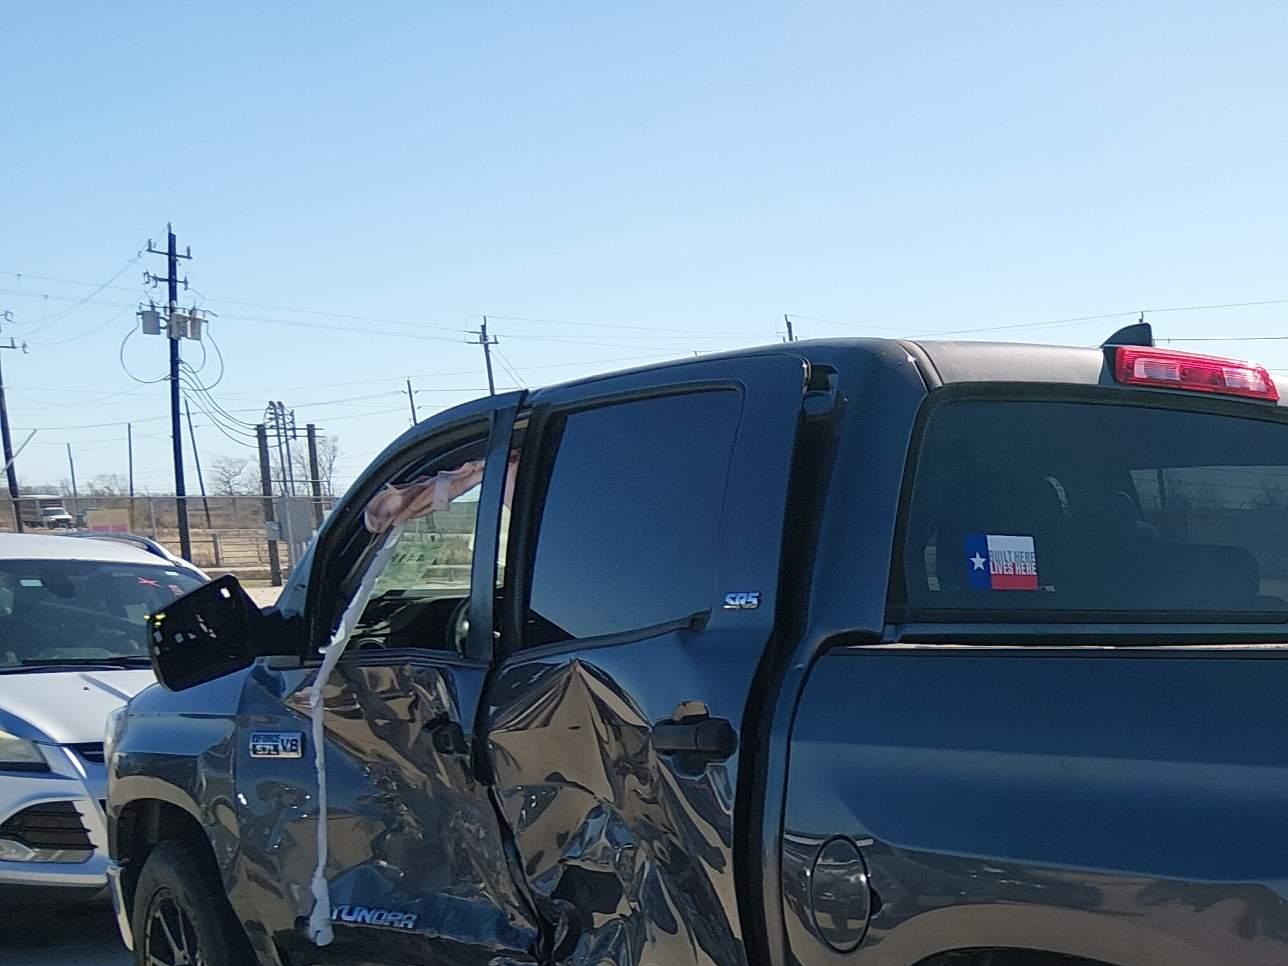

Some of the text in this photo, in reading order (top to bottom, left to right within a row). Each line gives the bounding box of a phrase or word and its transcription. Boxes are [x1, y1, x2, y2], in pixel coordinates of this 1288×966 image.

[989, 550, 1035, 564] BUILT HERE
[990, 562, 1037, 576] LIVES HERE
[331, 904, 417, 929] TUNDRA
